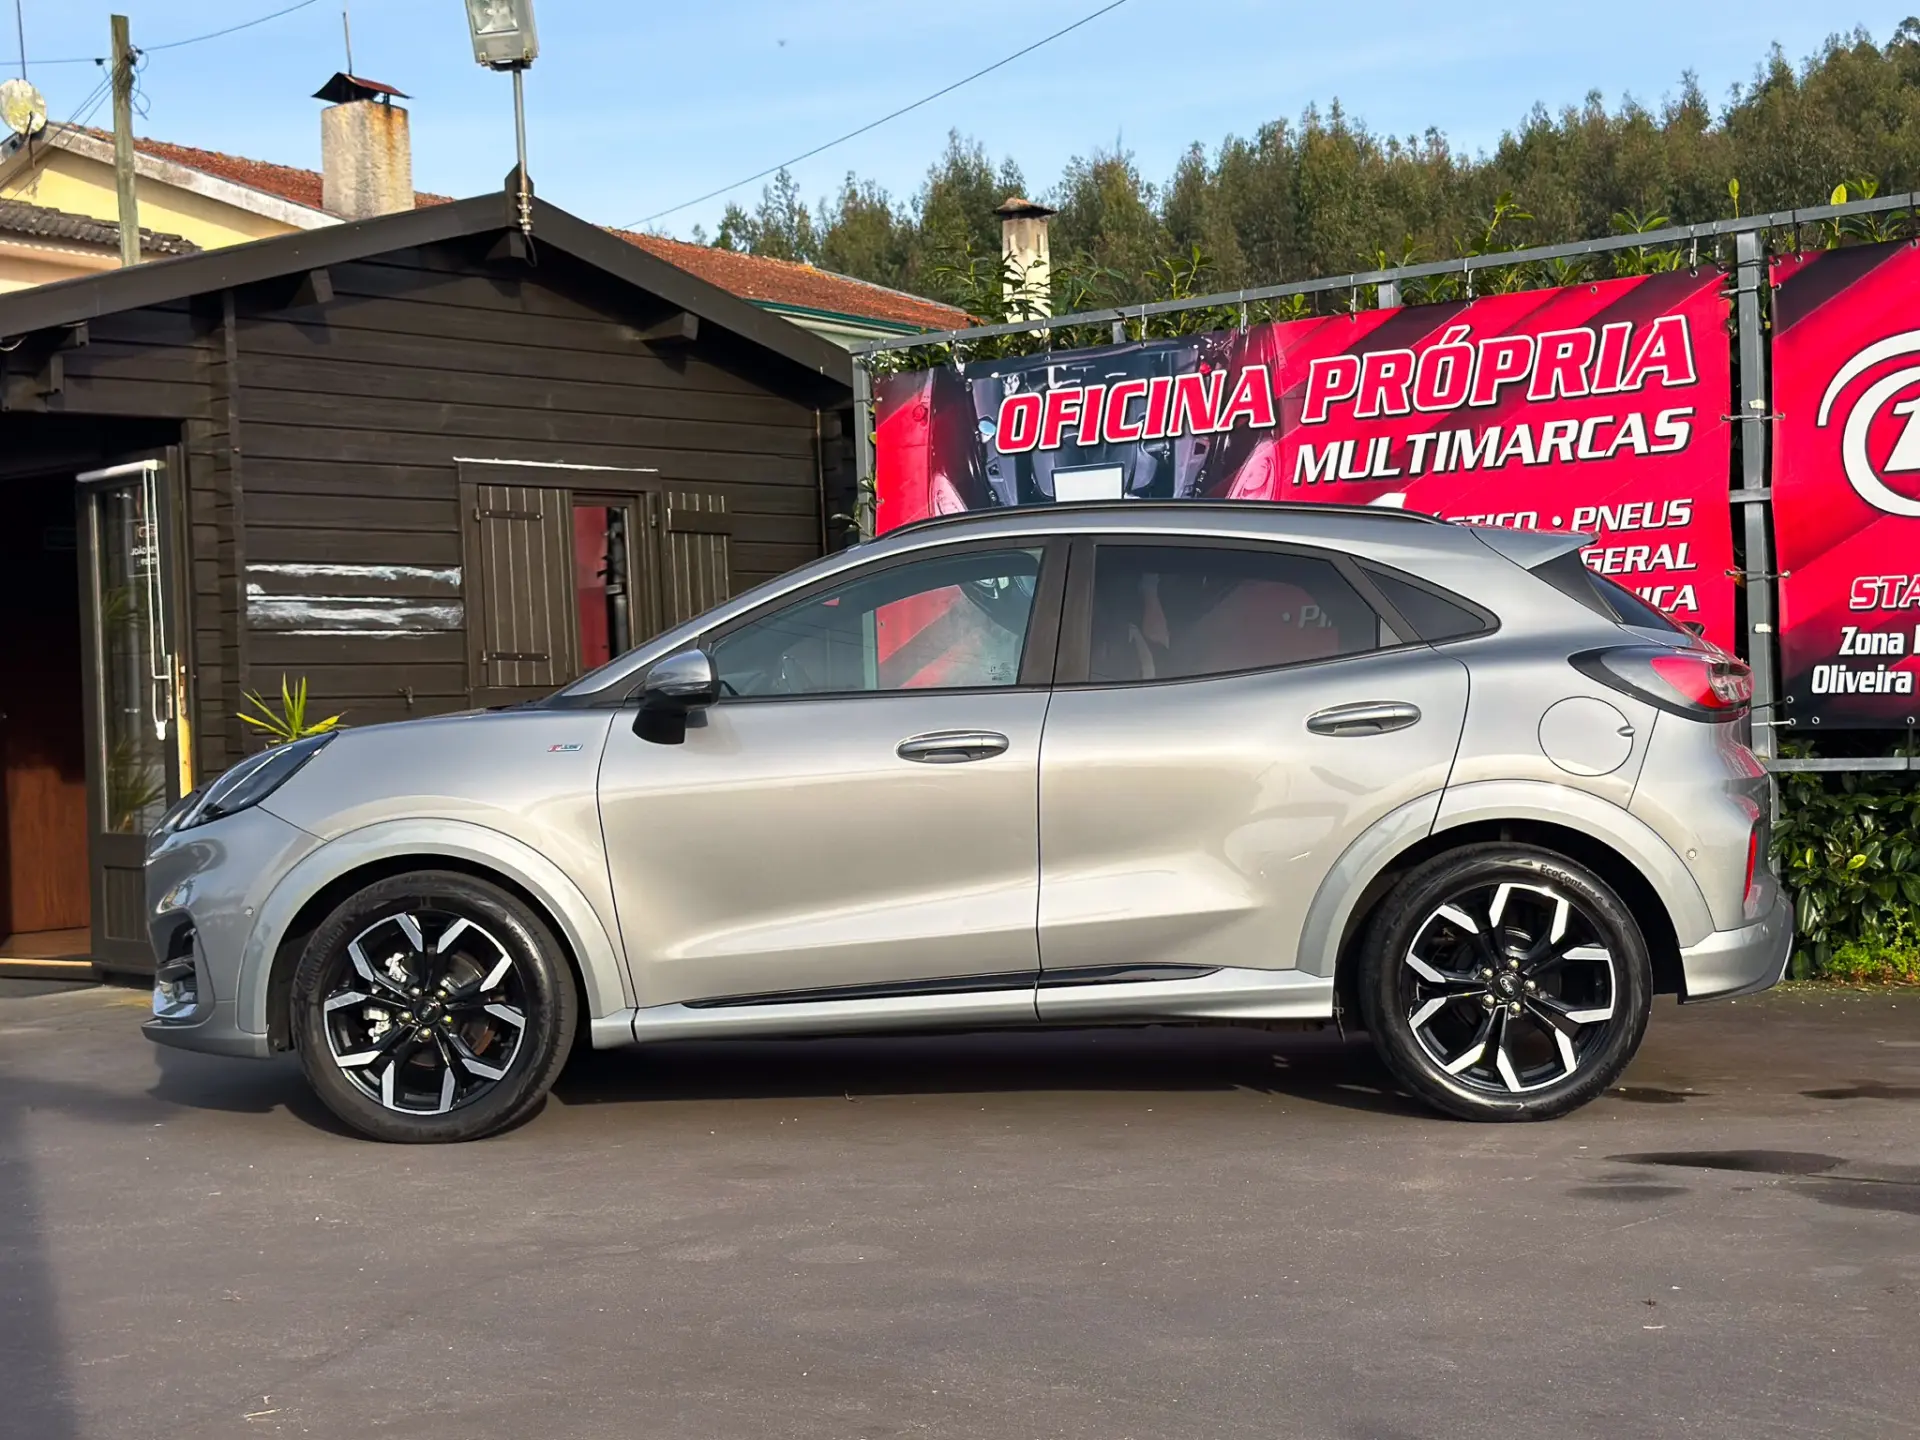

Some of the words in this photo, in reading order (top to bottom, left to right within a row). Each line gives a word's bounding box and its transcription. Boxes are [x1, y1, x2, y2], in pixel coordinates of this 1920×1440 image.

[995, 363, 1277, 455] OFICINA
[1300, 314, 1698, 425] PRÓPRIA
[1293, 406, 1696, 485] MULTIMARCAS
[1571, 498, 1693, 533] PNEUS
[1580, 542, 1698, 574] GERAL
[1635, 584, 1699, 613] ICA
[1838, 626, 1905, 655] Zona
[1811, 664, 1914, 694] Oliveira
